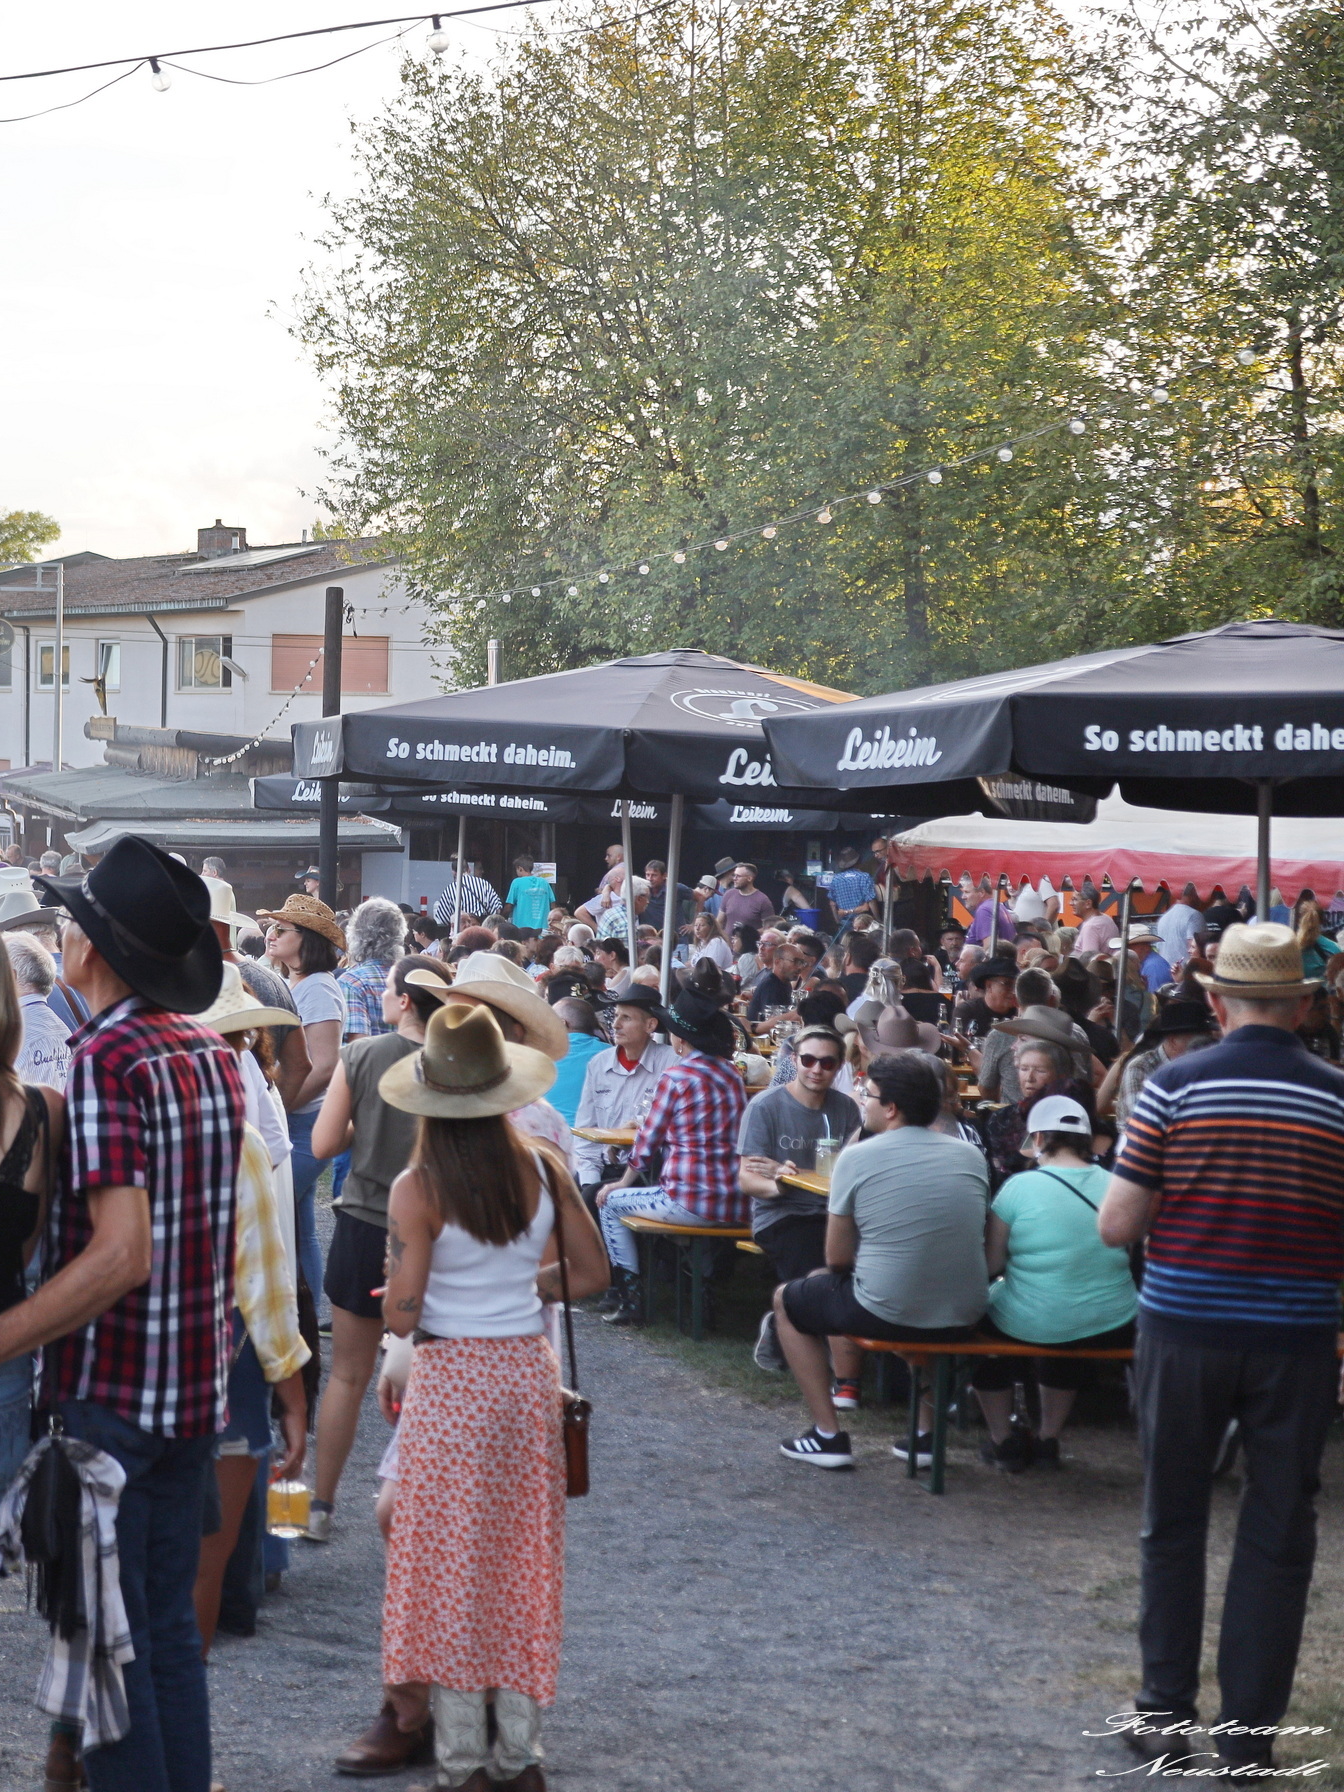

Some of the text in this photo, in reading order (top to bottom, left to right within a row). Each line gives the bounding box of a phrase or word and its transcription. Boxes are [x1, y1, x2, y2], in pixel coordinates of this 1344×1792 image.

[837, 725, 943, 771] Leikeim
[1084, 724, 1120, 751] So
[1129, 723, 1264, 751] schmeckt
[386, 737, 577, 769] So schmeckt daheim.
[441, 791, 495, 807] schmeckt
[500, 795, 548, 812] daheim.
[729, 805, 793, 823] Leikeim
